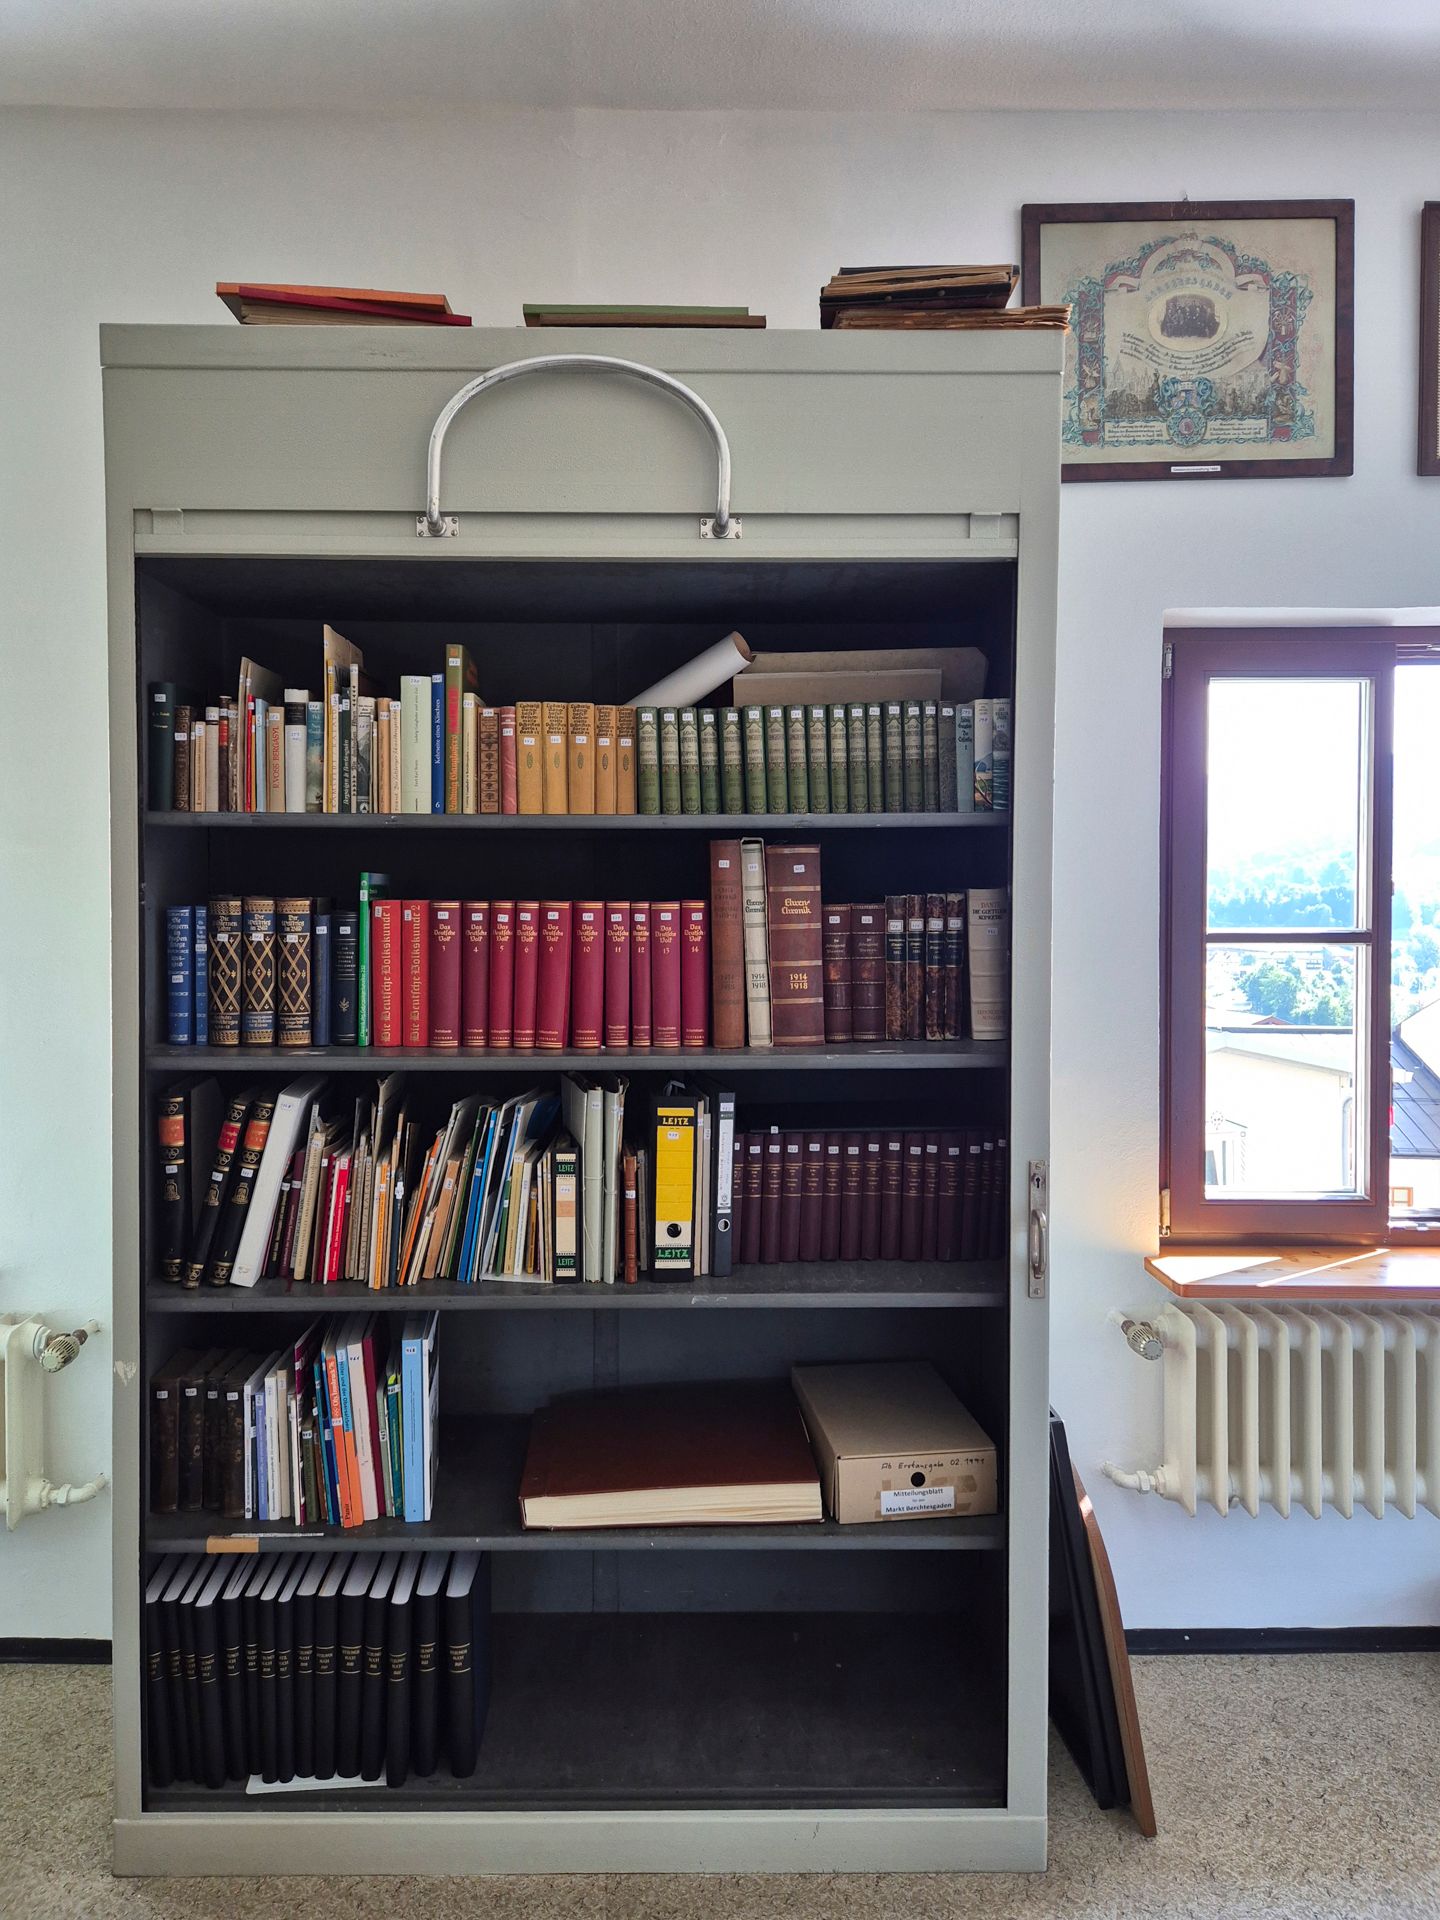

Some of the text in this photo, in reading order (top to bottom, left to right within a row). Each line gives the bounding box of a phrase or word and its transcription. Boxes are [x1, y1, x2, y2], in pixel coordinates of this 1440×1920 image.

[782, 906, 812, 915] Chronik
[381, 913, 392, 974] Volkskunde
[411, 913, 421, 974] Volkskunde
[381, 1025, 391, 1042] Die
[410, 1025, 420, 1042] Die
[662, 1117, 689, 1125] LEITZ
[558, 1164, 575, 1172] LEITZ
[657, 1249, 689, 1258] LEITZ
[558, 1258, 575, 1266] LEITZ
[898, 1461, 944, 1472] Erstausgabe
[893, 1488, 944, 1497] Mitteilungsblatt
[886, 1503, 952, 1513] Markt Berchtesgaden
